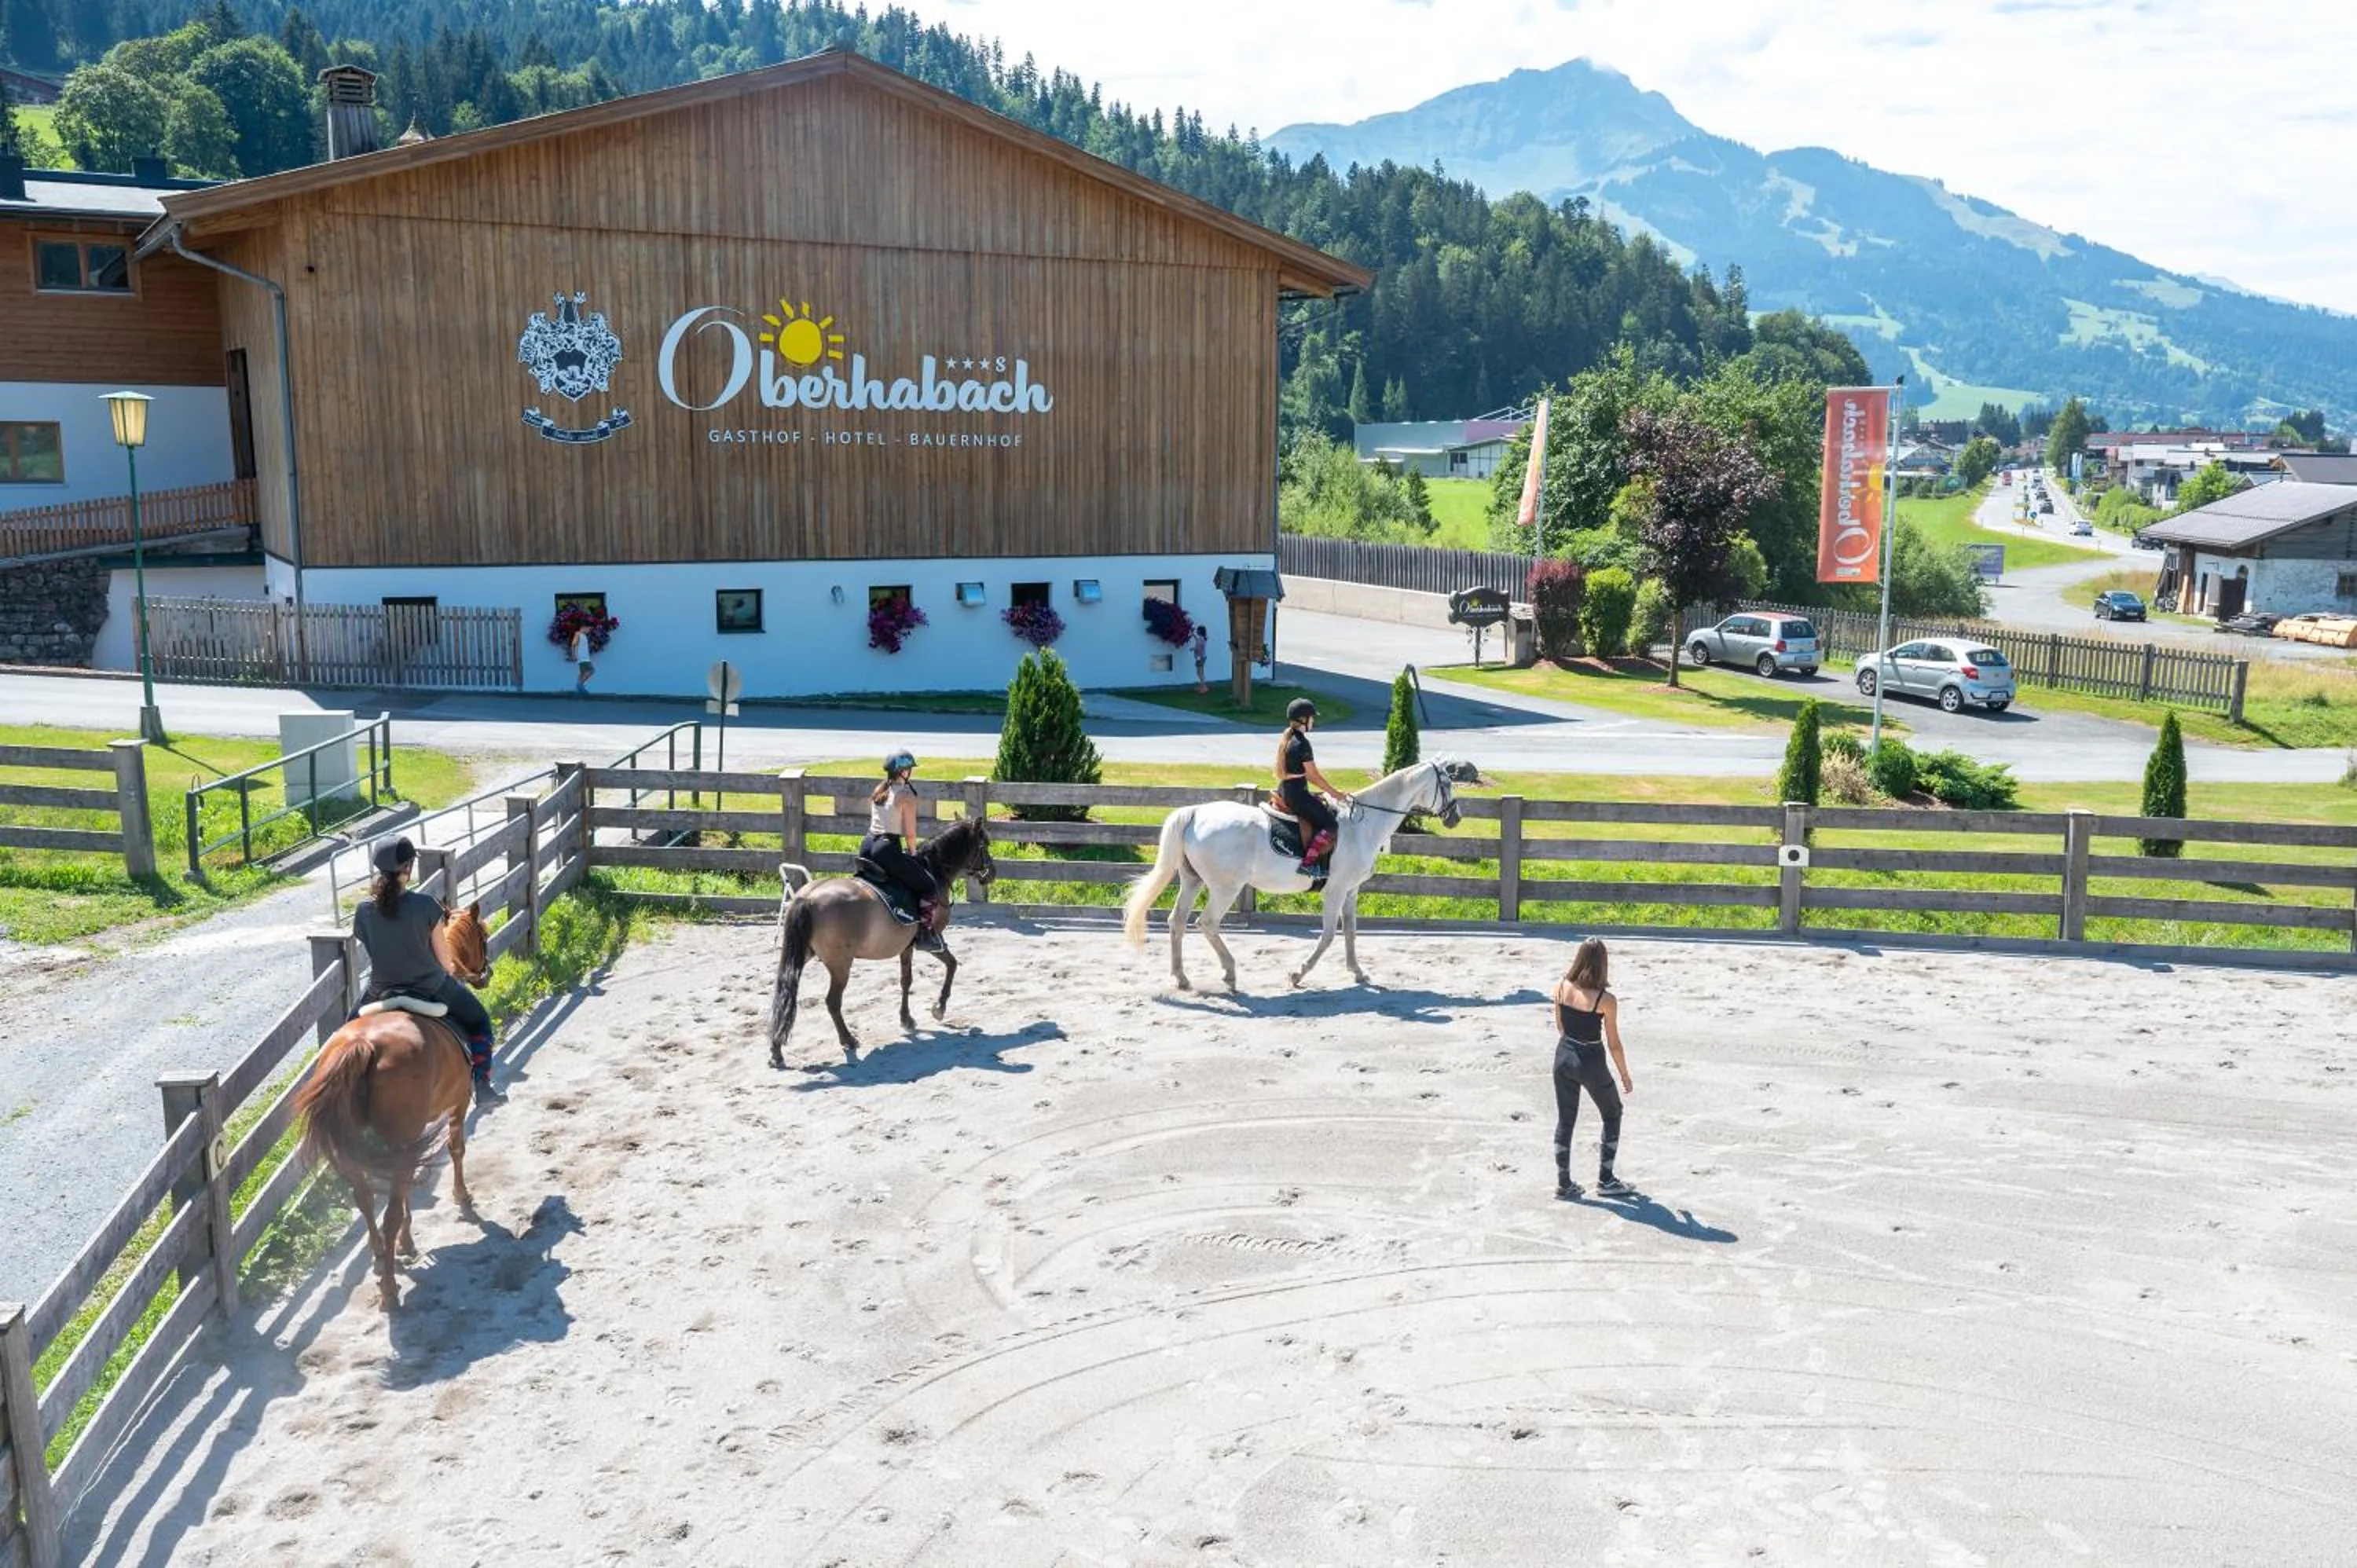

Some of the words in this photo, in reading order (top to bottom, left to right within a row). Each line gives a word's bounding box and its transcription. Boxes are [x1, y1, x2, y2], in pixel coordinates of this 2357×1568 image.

[658, 306, 1054, 413] Oberhabach
[709, 430, 801, 444] GASTHOF
[826, 431, 885, 445] HOTEL
[911, 433, 1022, 447] BAUERNHOF
